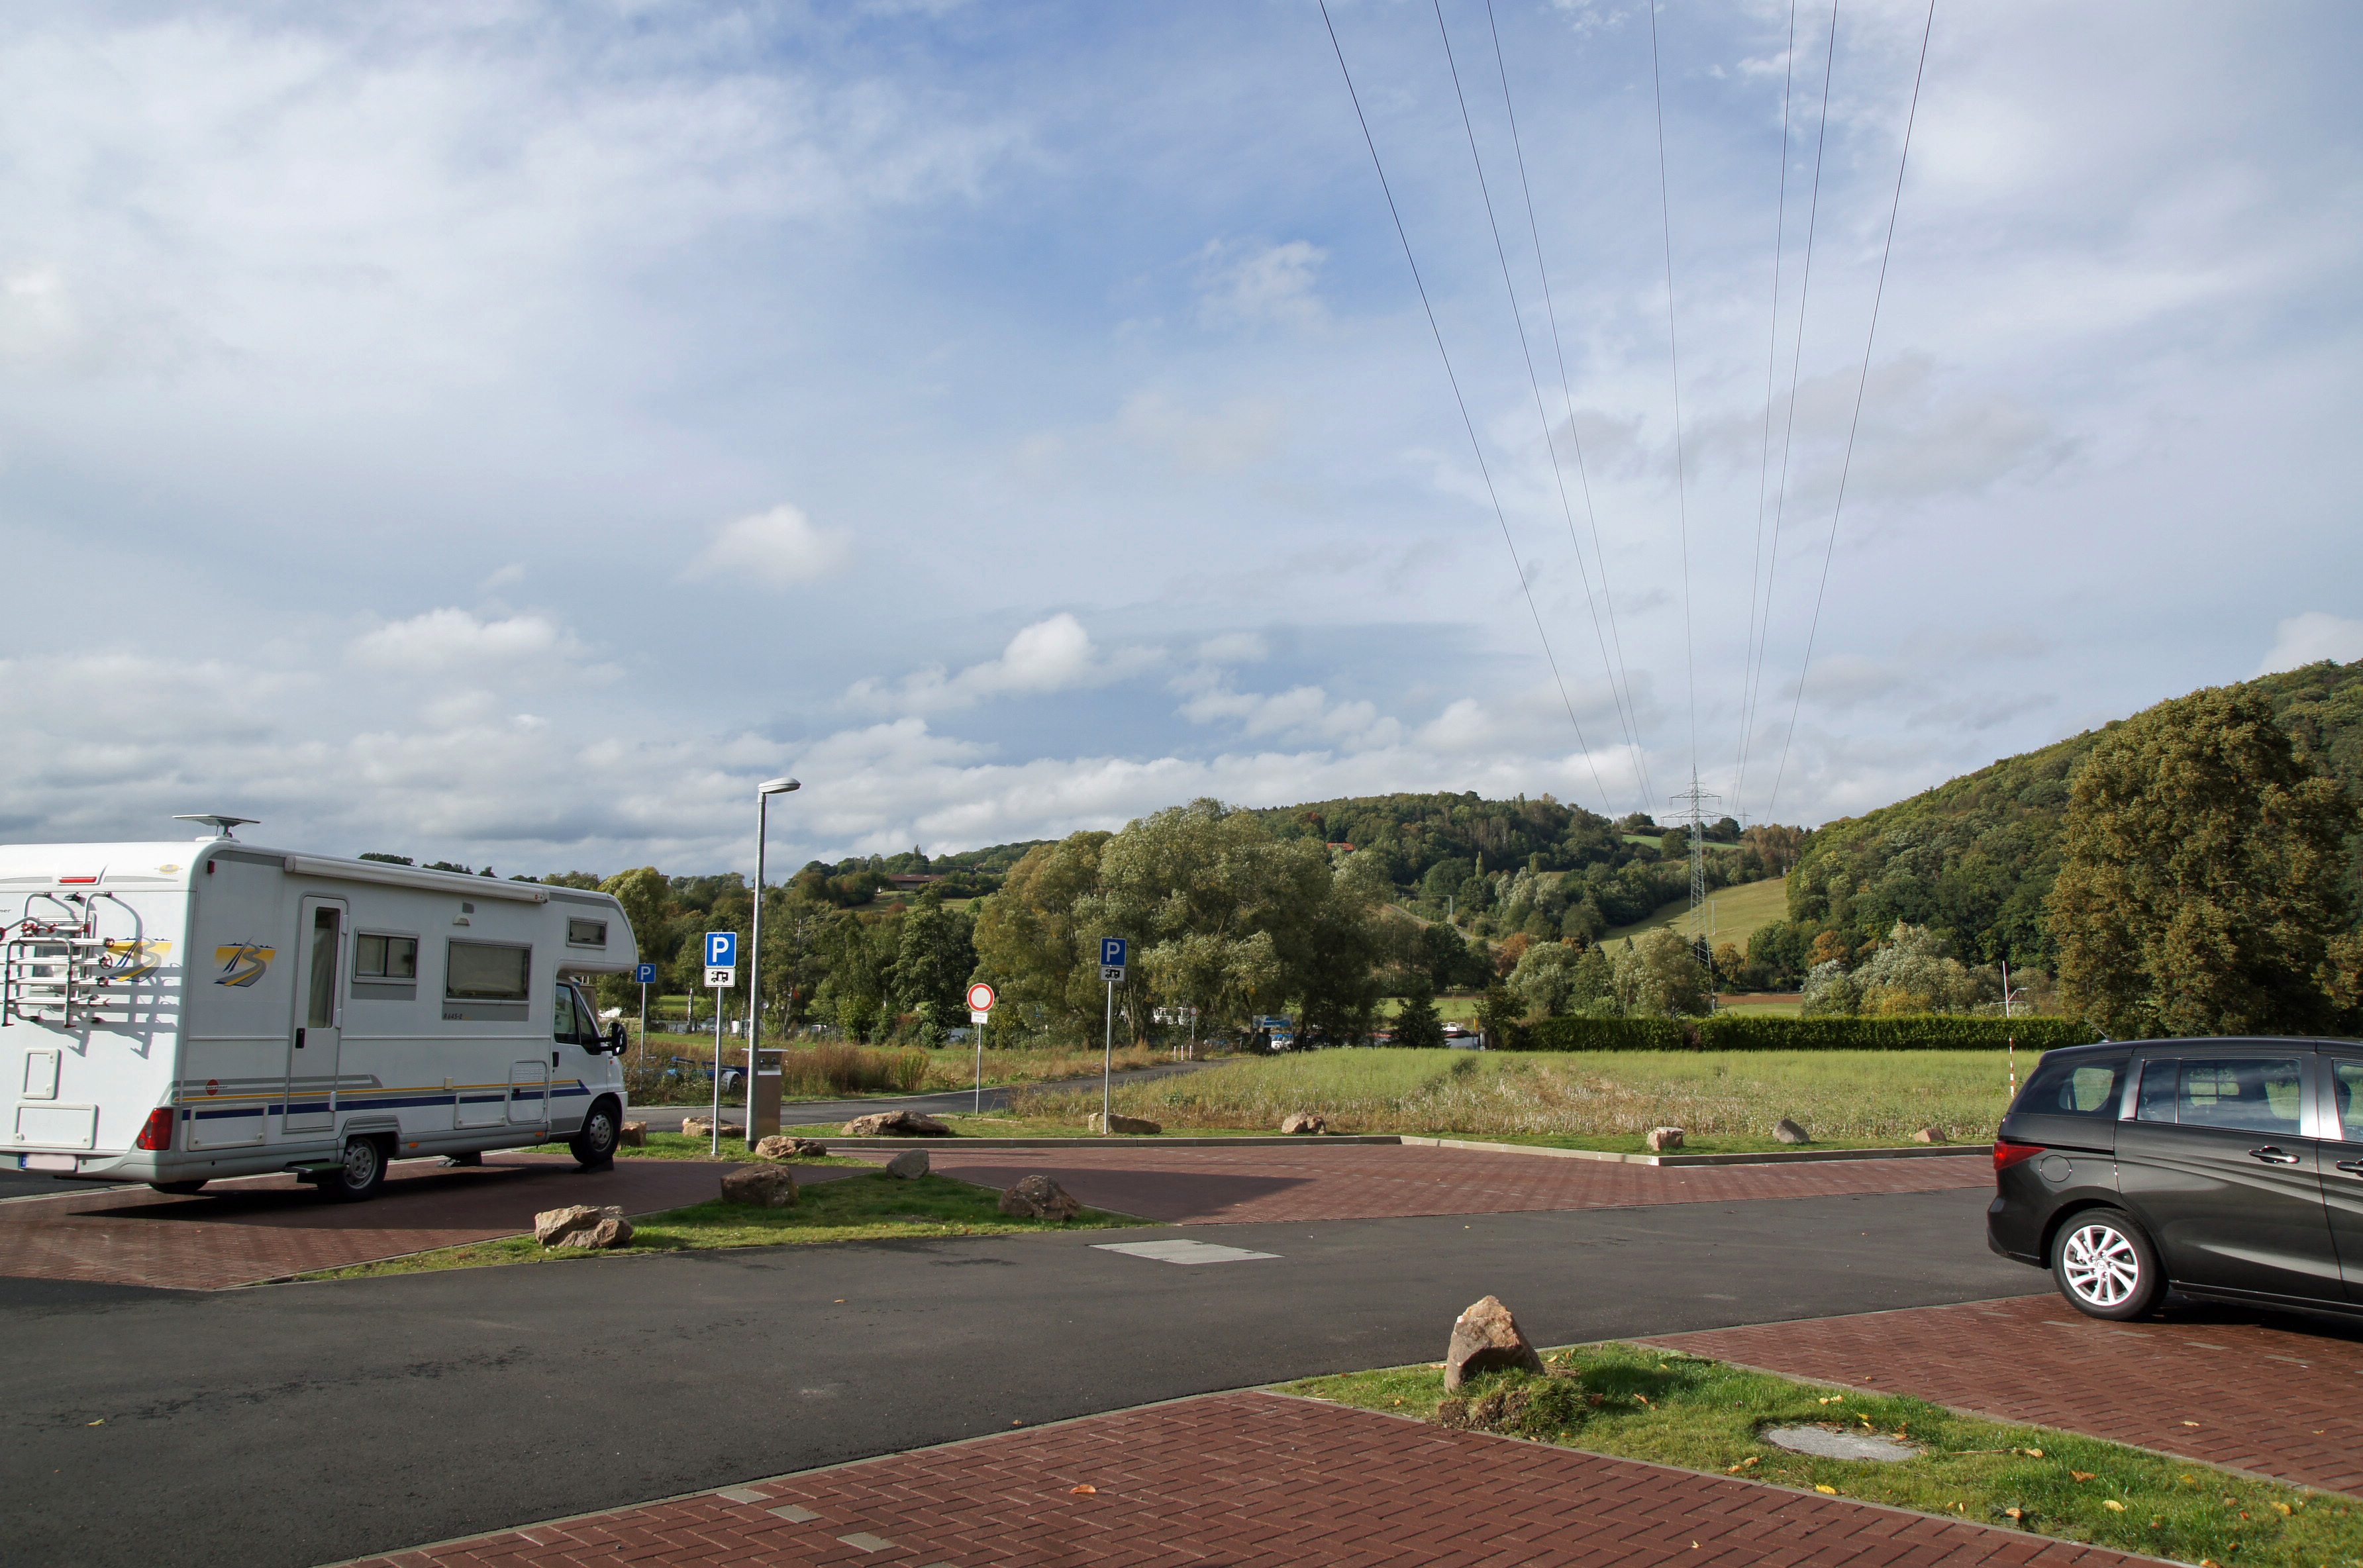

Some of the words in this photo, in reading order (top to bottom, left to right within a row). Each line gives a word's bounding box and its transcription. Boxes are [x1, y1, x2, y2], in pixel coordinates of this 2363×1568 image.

[712, 937, 729, 963] P
[1107, 942, 1121, 962] P
[640, 966, 651, 980] P
